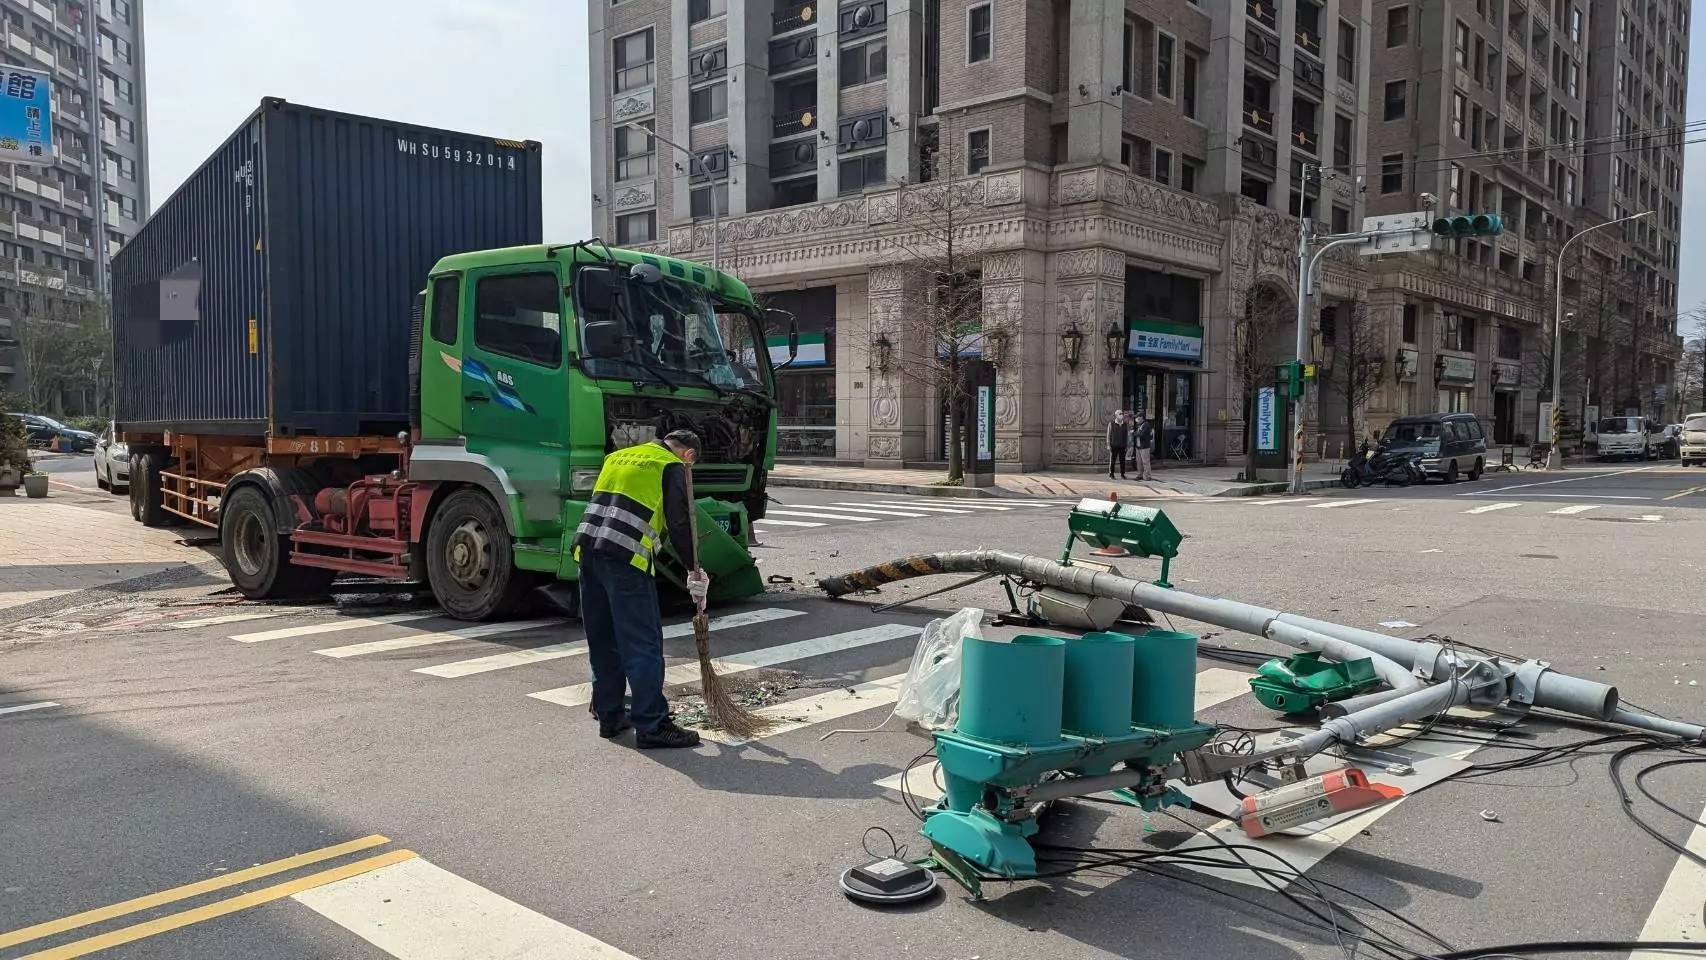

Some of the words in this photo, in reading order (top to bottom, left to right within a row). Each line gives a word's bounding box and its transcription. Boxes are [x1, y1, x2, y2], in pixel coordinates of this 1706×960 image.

[1160, 336, 1191, 352] FamilyMart
[497, 370, 514, 386] ABS
[979, 390, 987, 449] FamilyMart
